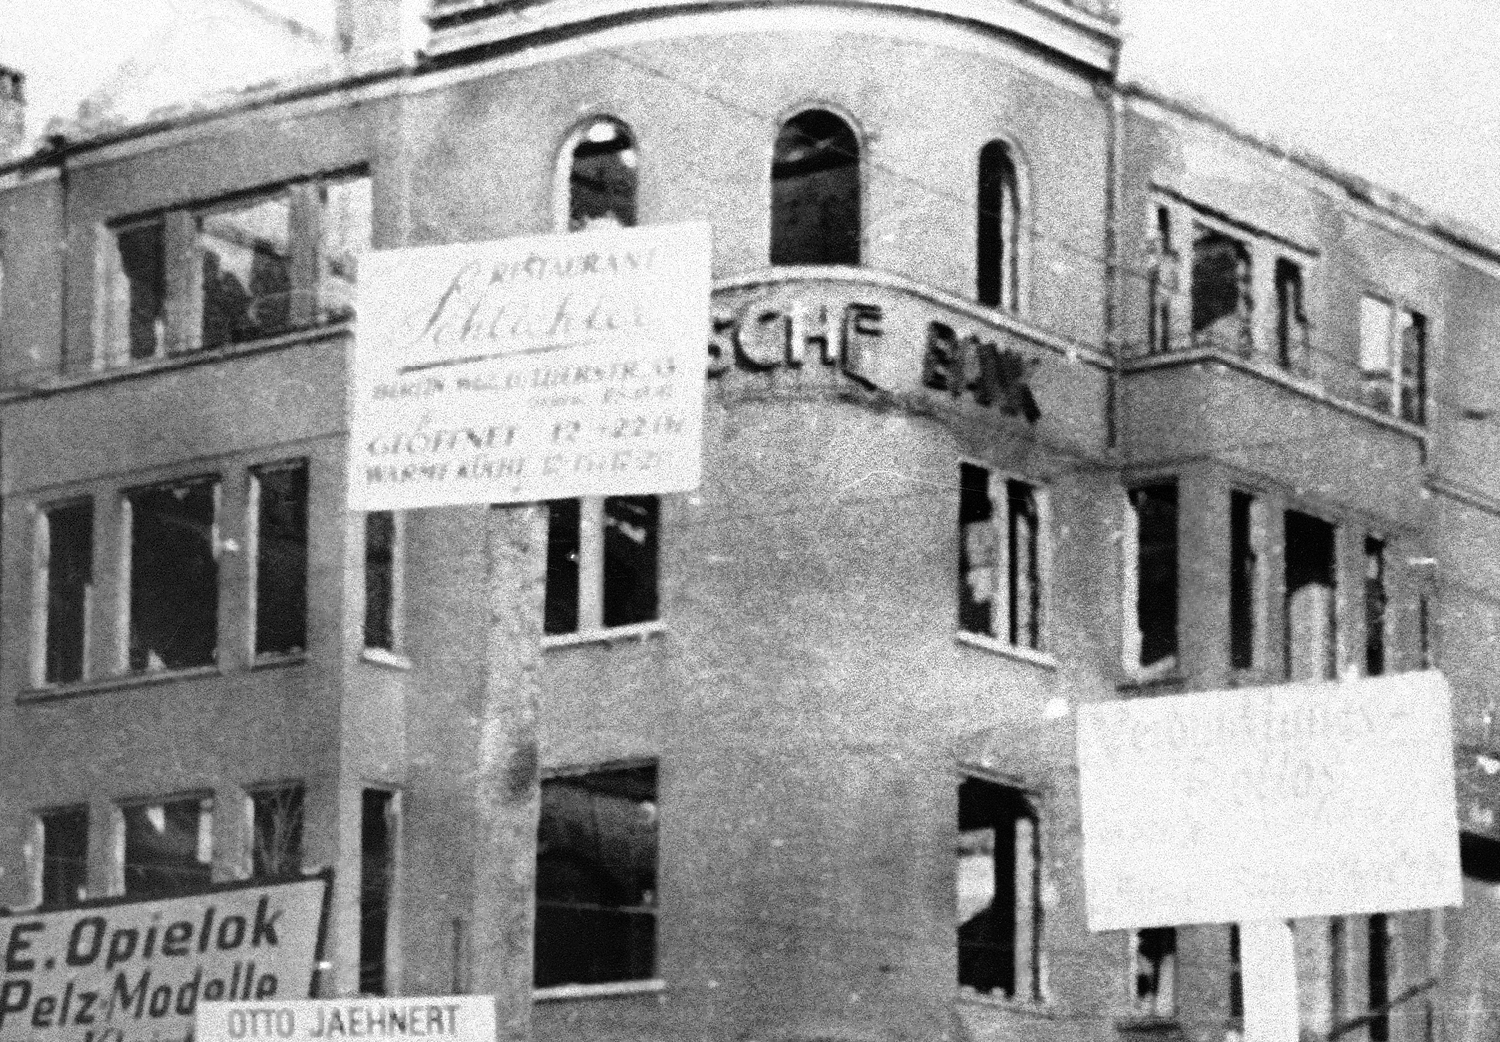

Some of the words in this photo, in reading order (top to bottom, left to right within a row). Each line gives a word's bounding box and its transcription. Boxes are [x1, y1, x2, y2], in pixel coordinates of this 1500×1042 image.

[65, 894, 286, 971] Opielok
[226, 1008, 296, 1039] OTTO
[309, 1004, 461, 1039] JAEHNERT
